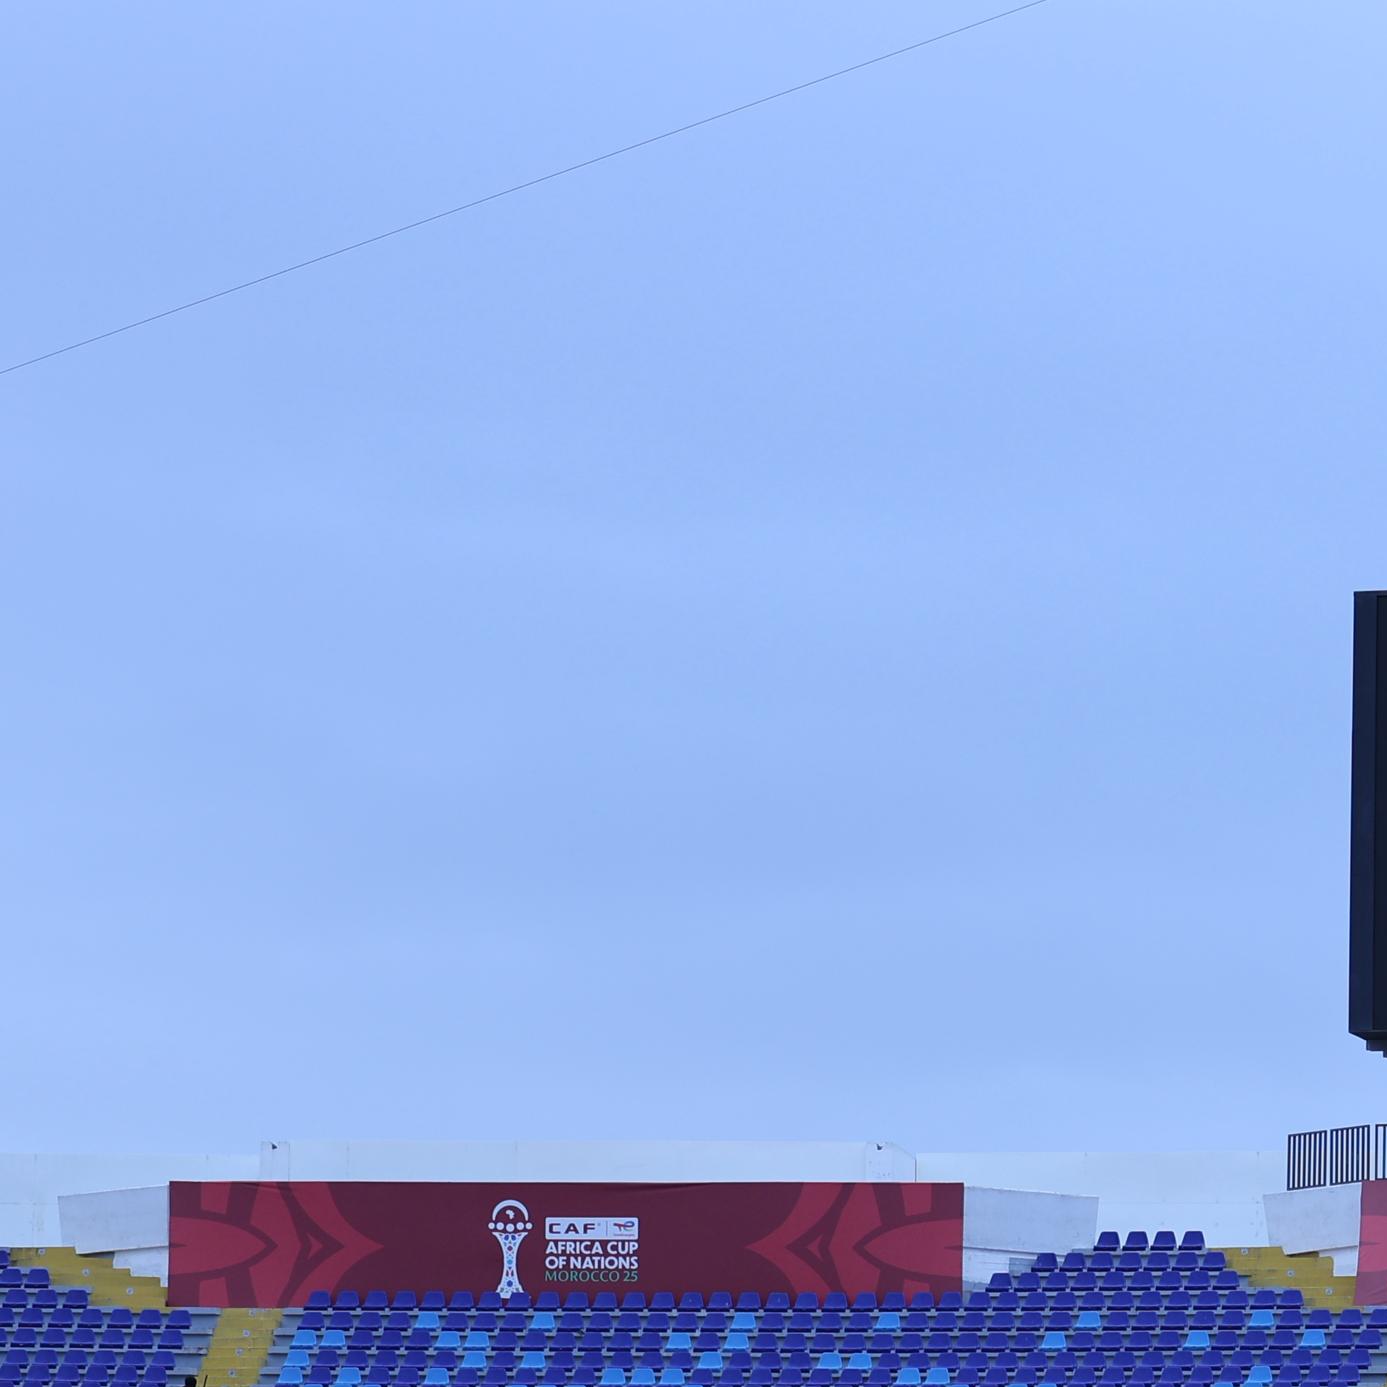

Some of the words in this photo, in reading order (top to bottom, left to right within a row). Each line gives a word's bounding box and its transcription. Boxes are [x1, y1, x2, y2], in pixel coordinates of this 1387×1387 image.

[549, 1223, 595, 1234] CAF
[545, 1242, 603, 1254] AFRICA
[607, 1242, 638, 1254] CUP
[545, 1256, 567, 1269] OF
[570, 1256, 638, 1269] NATIONS
[545, 1270, 620, 1282] MOROCCO
[623, 1270, 638, 1282] 25
